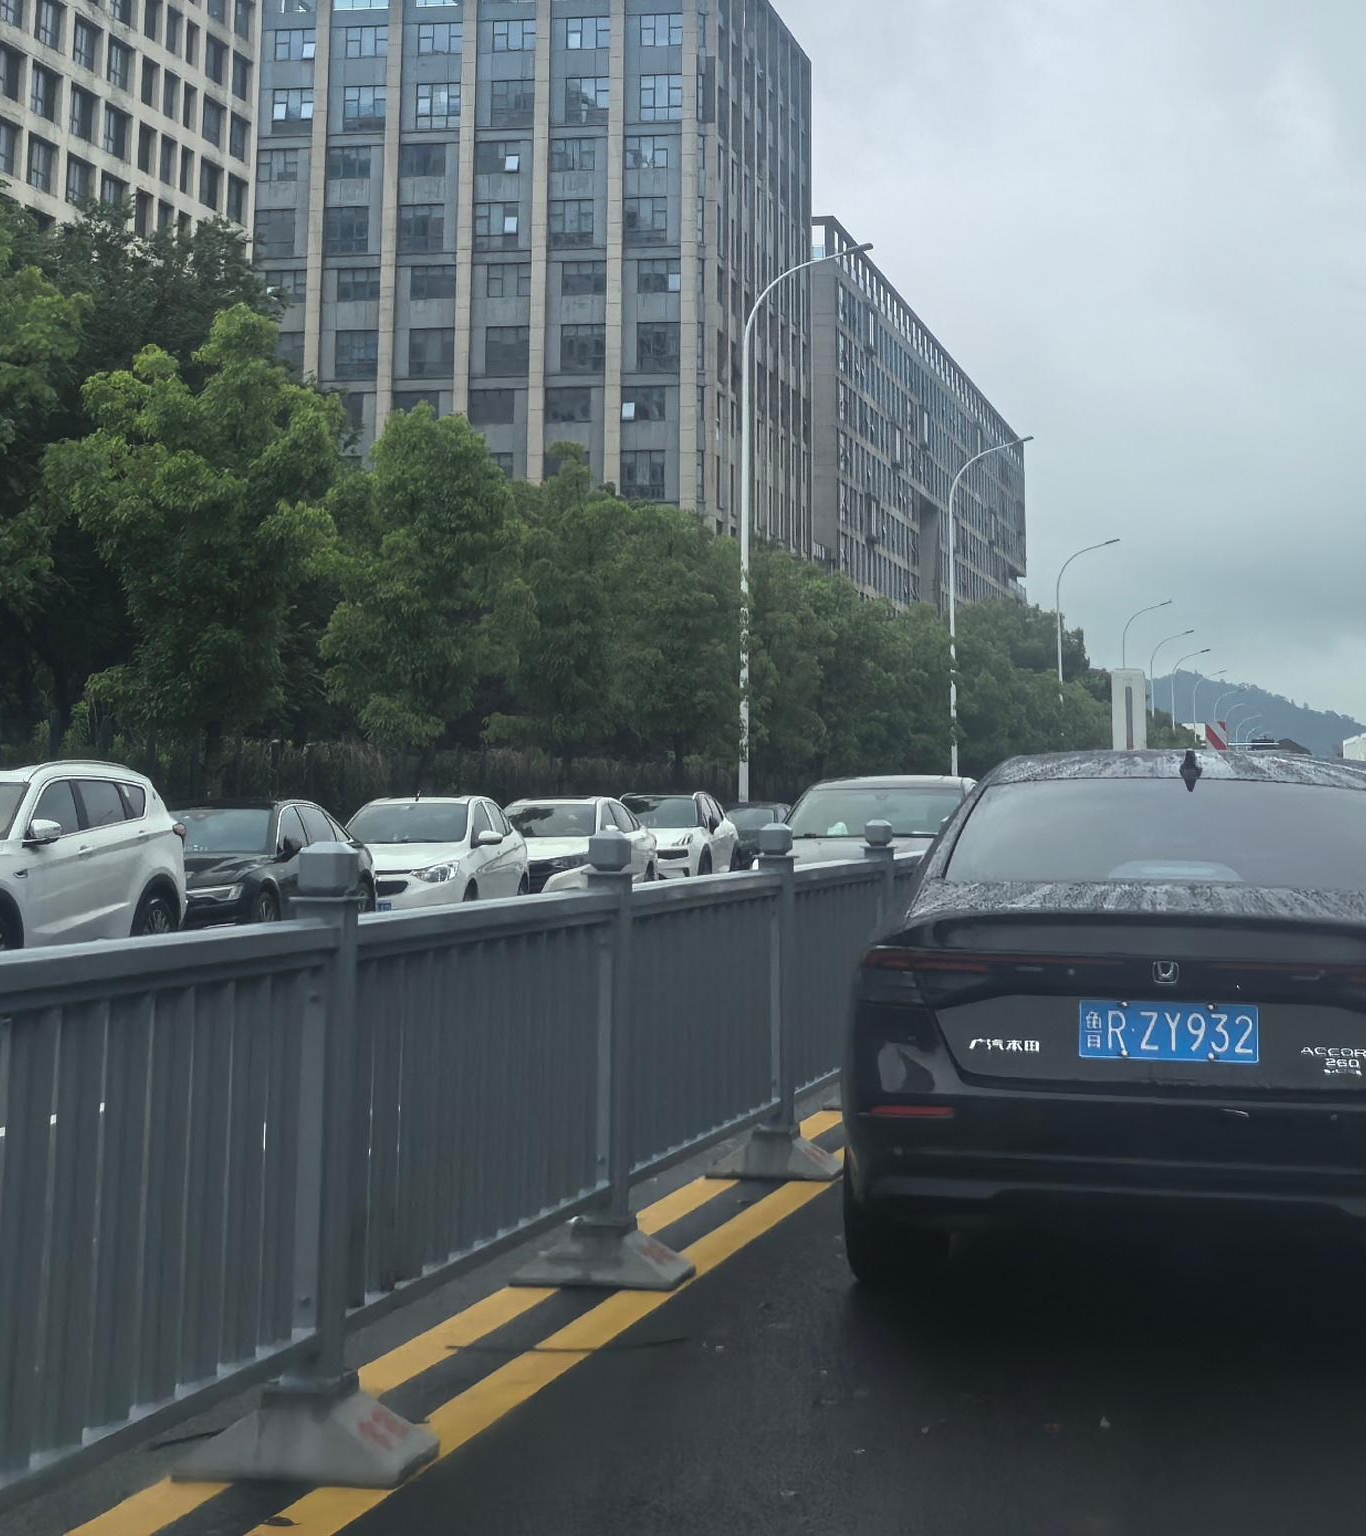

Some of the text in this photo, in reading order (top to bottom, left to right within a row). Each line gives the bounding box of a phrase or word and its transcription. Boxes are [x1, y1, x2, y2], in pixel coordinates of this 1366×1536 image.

[968, 1038, 1040, 1052] 广汽本田
[1325, 1058, 1360, 1068] 260
